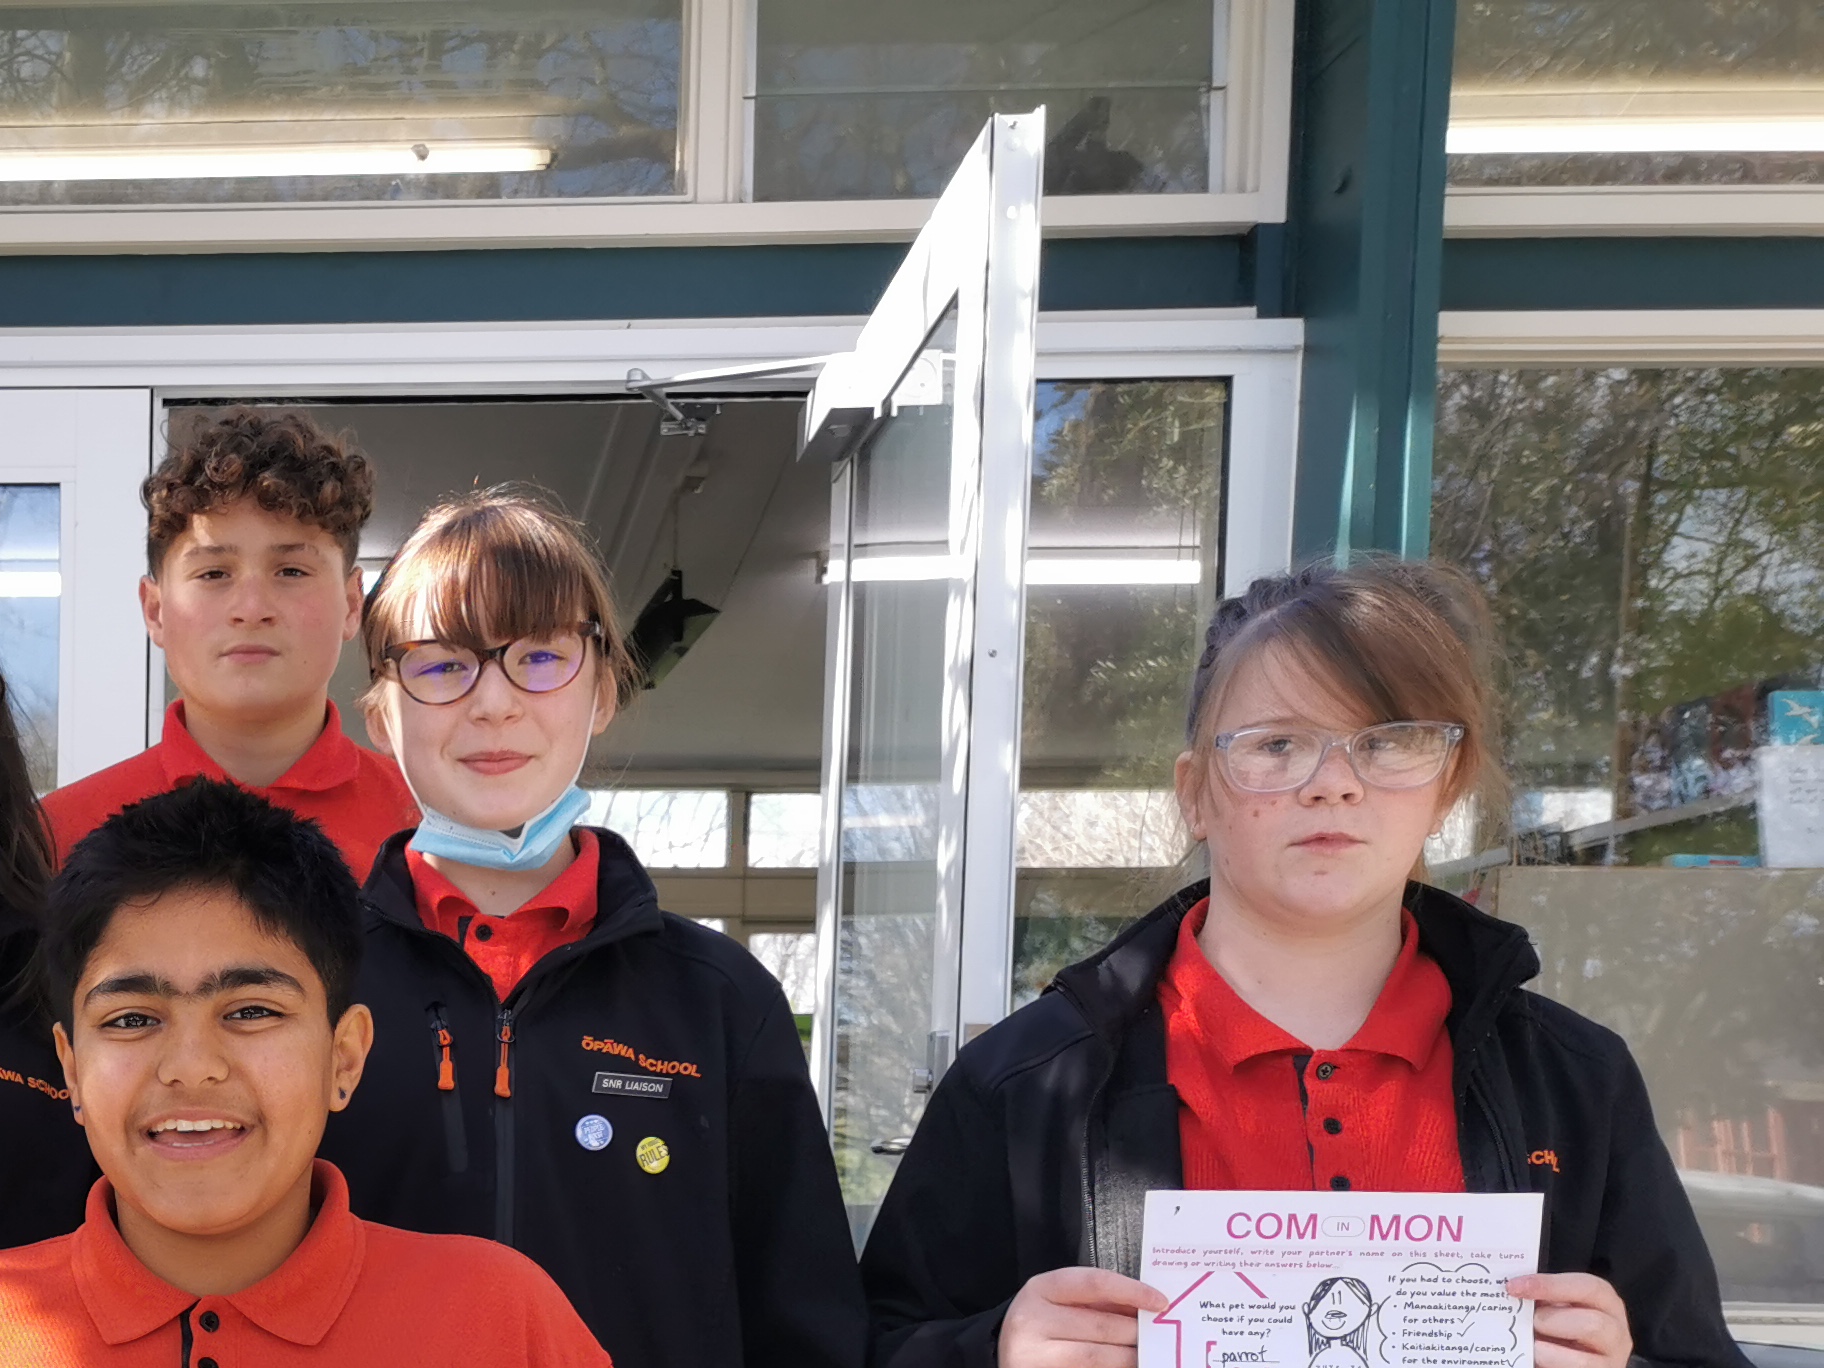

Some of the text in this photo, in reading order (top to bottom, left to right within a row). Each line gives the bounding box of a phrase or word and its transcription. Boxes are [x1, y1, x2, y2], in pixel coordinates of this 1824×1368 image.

[638, 1054, 702, 1077] SCHOOL
[27, 1077, 70, 1099] SCHOO
[602, 1079, 664, 1092] SNR LIAISON
[1227, 1212, 1463, 1242] COM IN MON
[1199, 1300, 1297, 1314] What pet would you
[1201, 1313, 1293, 1326] choose if you could
[1402, 1315, 1456, 1325] for others
[1221, 1327, 1272, 1340] have any?
[1402, 1328, 1453, 1341] Friendship
[1222, 1346, 1266, 1368] parrot
